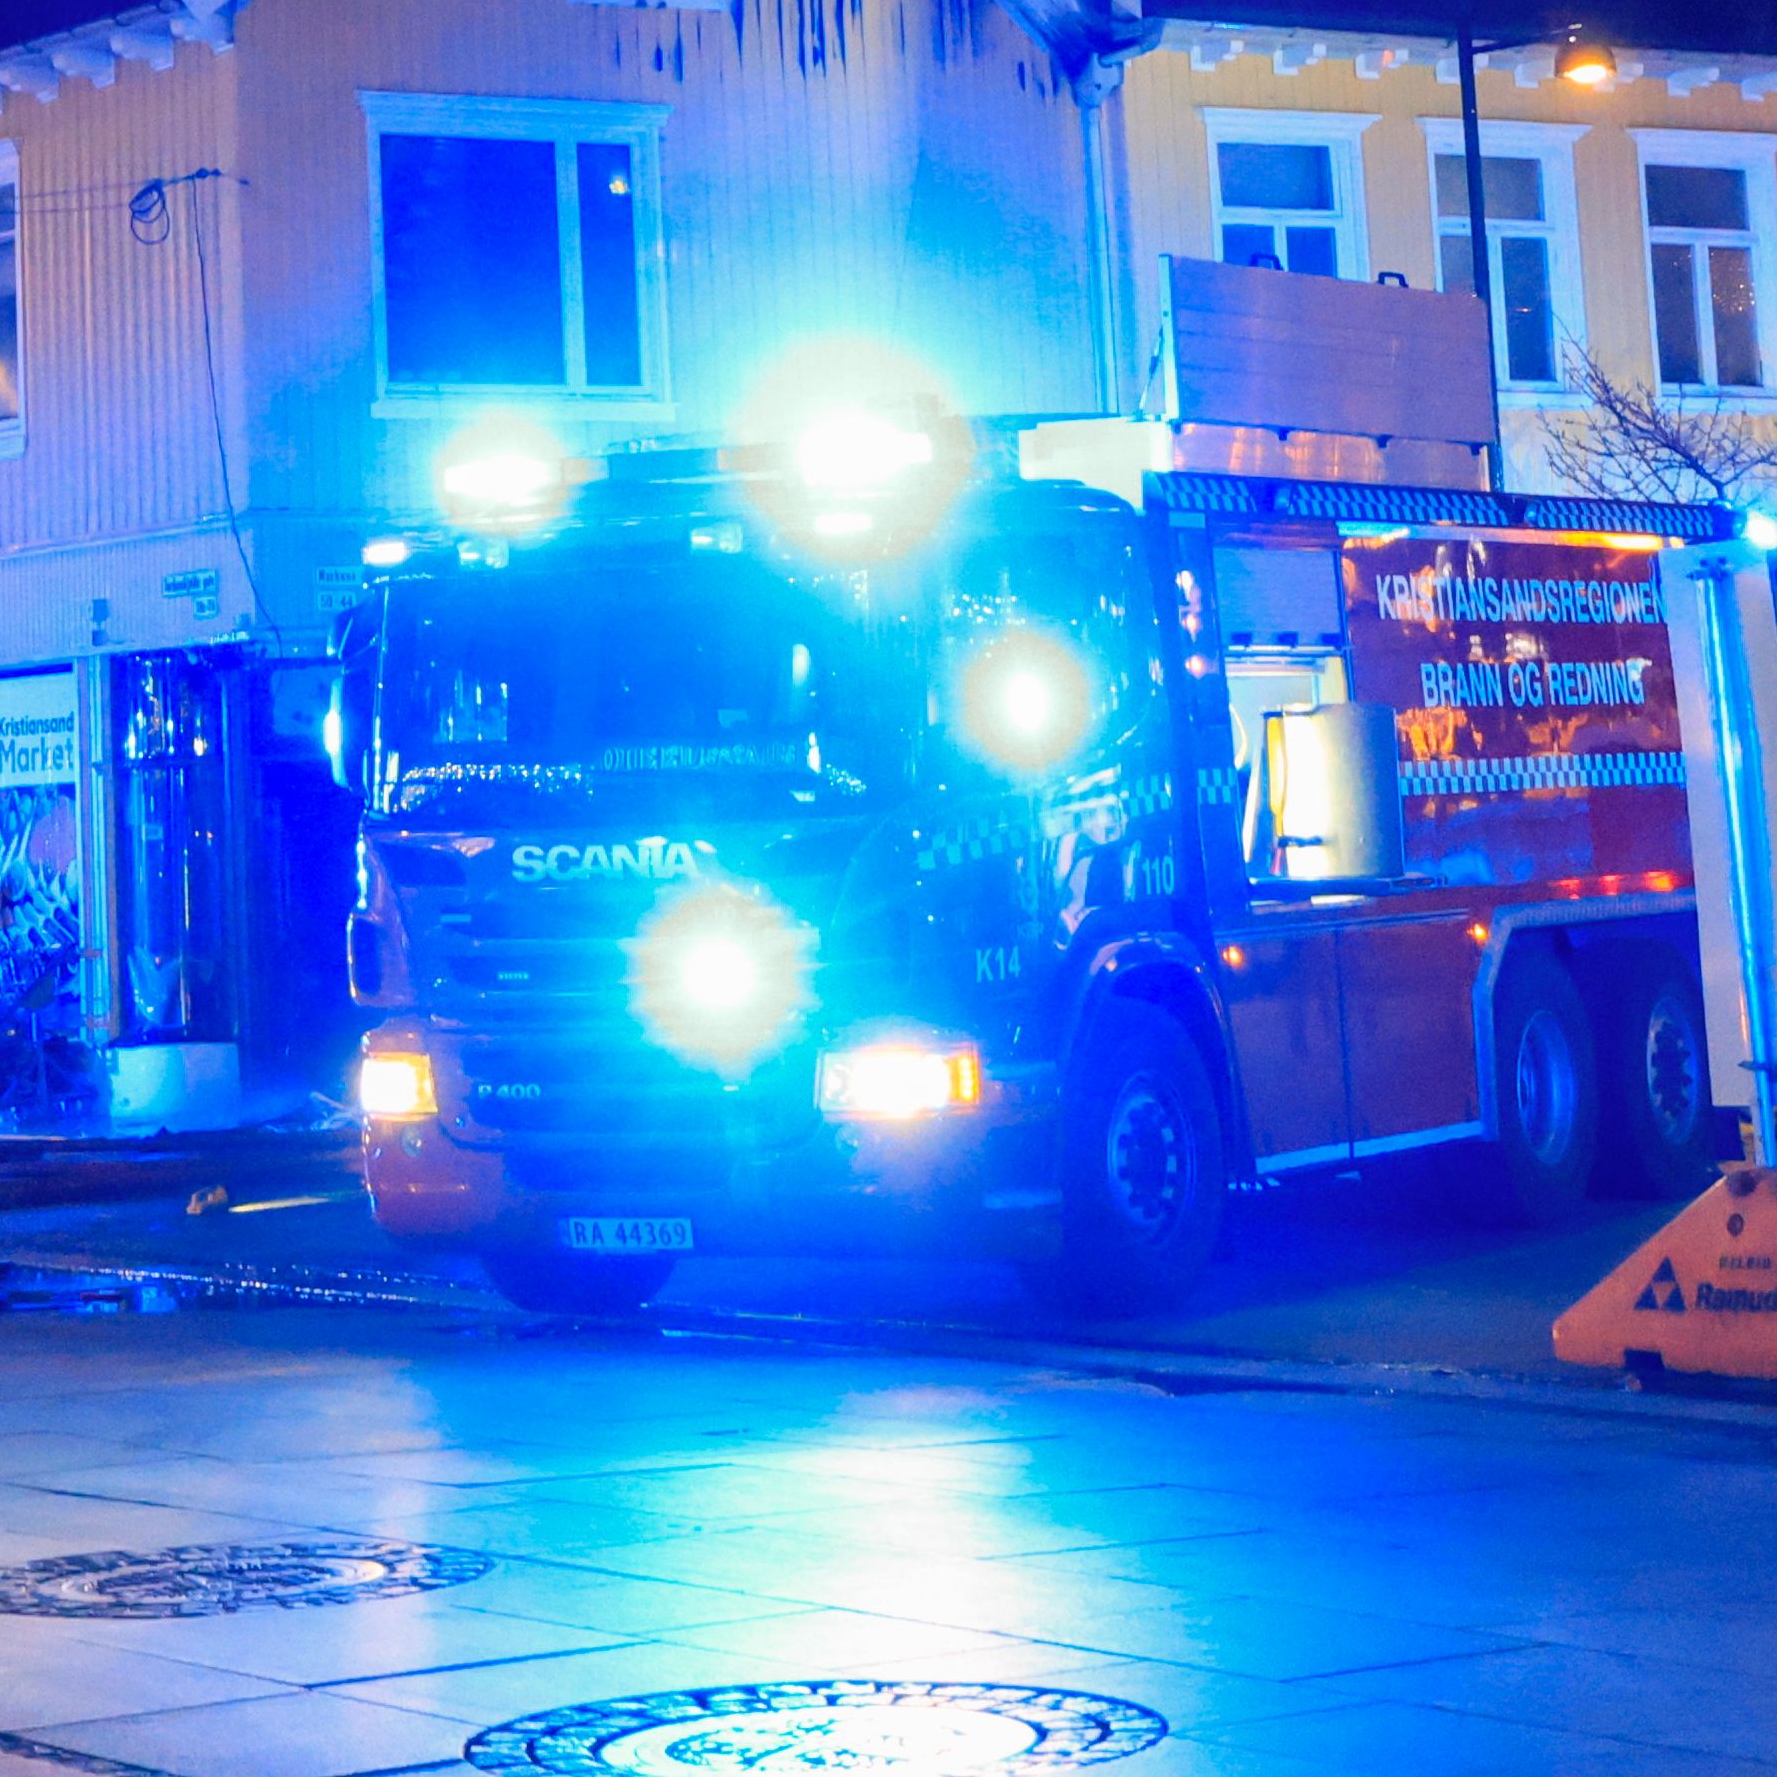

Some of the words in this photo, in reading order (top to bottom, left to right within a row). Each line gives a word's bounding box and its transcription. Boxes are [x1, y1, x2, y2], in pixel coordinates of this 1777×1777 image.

[1375, 573, 1668, 624] KRISTIANSANDSREGIONEN
[1420, 662, 1504, 707] BRANN
[1507, 661, 1544, 706] OG
[1547, 661, 1645, 706] REDNING
[512, 842, 700, 882] SCANIA
[1141, 855, 1175, 896] 110
[975, 945, 1021, 983] K14
[574, 1221, 604, 1246] RA
[615, 1222, 686, 1246] 44369
